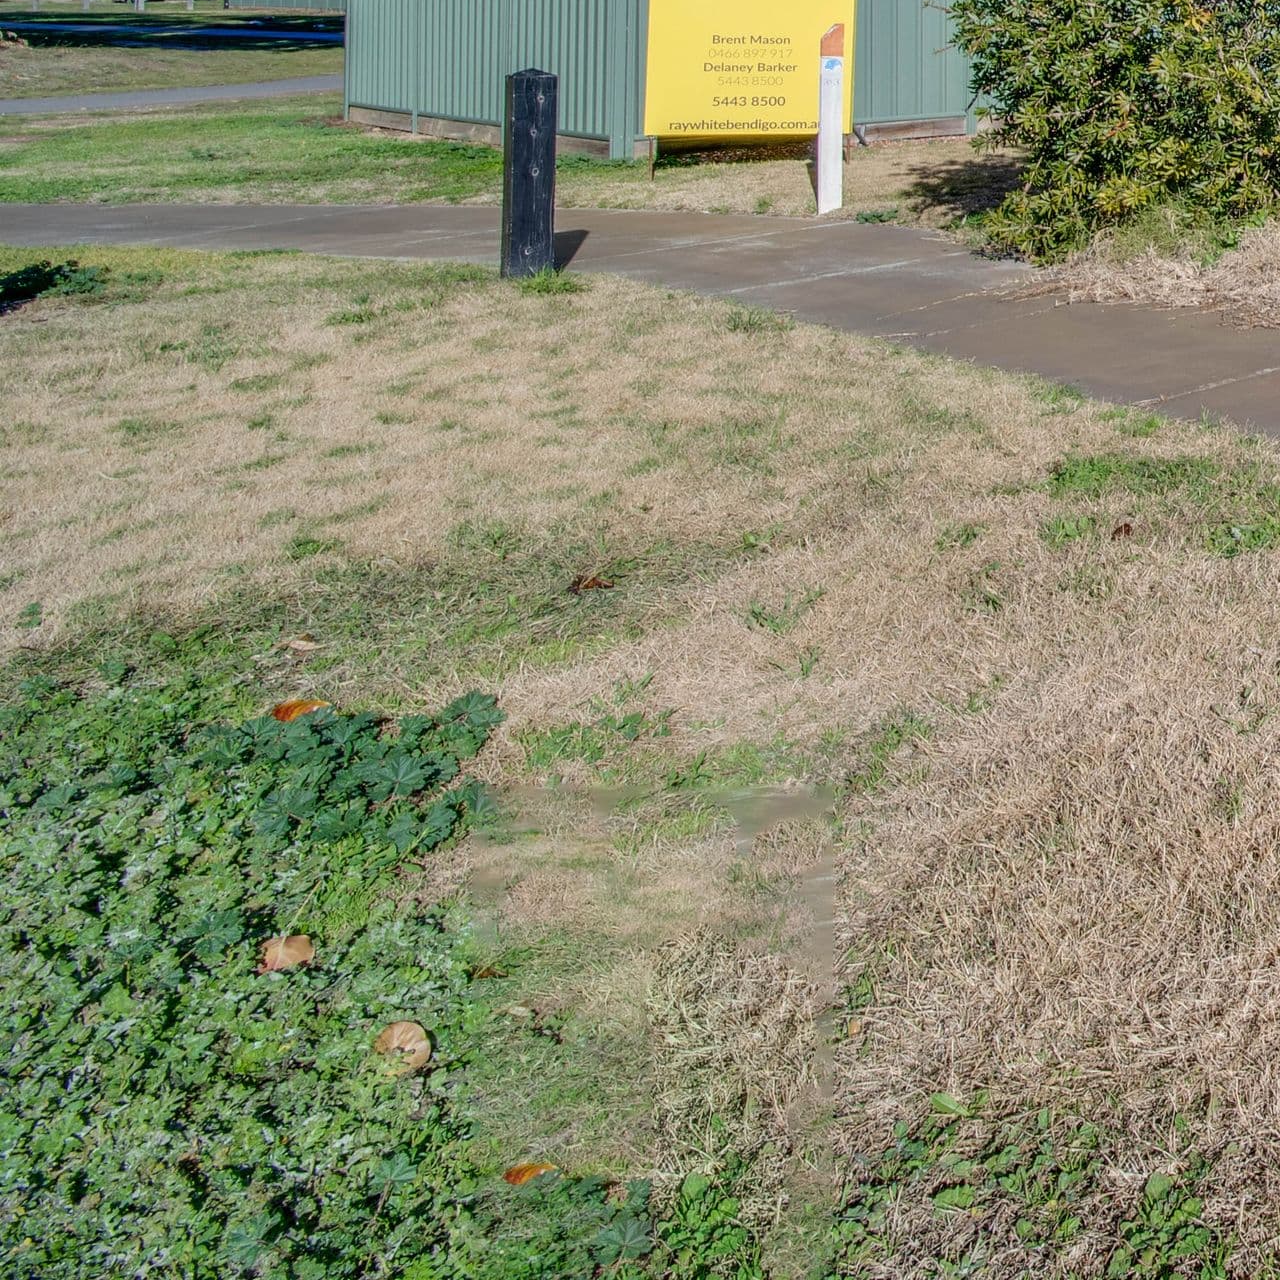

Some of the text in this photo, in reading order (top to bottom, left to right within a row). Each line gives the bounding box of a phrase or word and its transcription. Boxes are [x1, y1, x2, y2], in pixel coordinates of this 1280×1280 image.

[712, 34, 792, 45] Brent Mason
[703, 62, 799, 74] Delaney Barker
[717, 76, 784, 87] 5443 8500
[712, 96, 786, 107] 5443 8500
